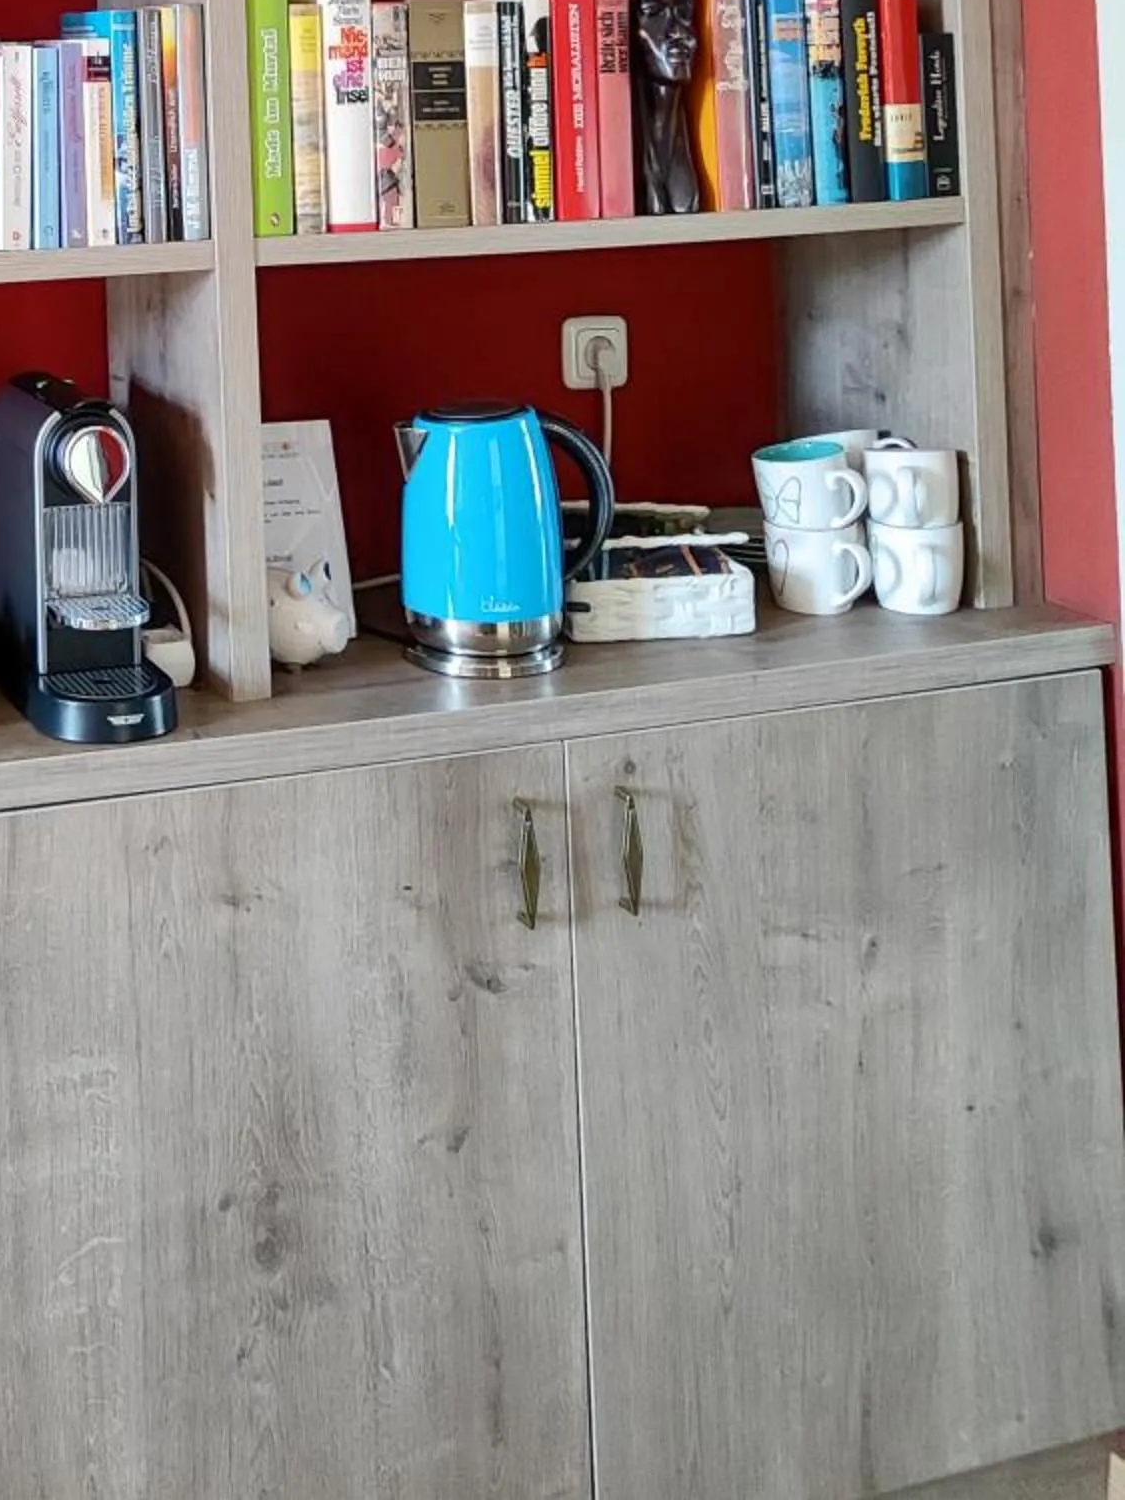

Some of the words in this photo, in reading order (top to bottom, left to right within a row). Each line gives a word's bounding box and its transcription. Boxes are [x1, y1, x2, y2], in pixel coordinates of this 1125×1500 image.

[852, 17, 868, 70] Forsyth
[856, 73, 872, 141] Frederick
[530, 149, 551, 208] simmel
